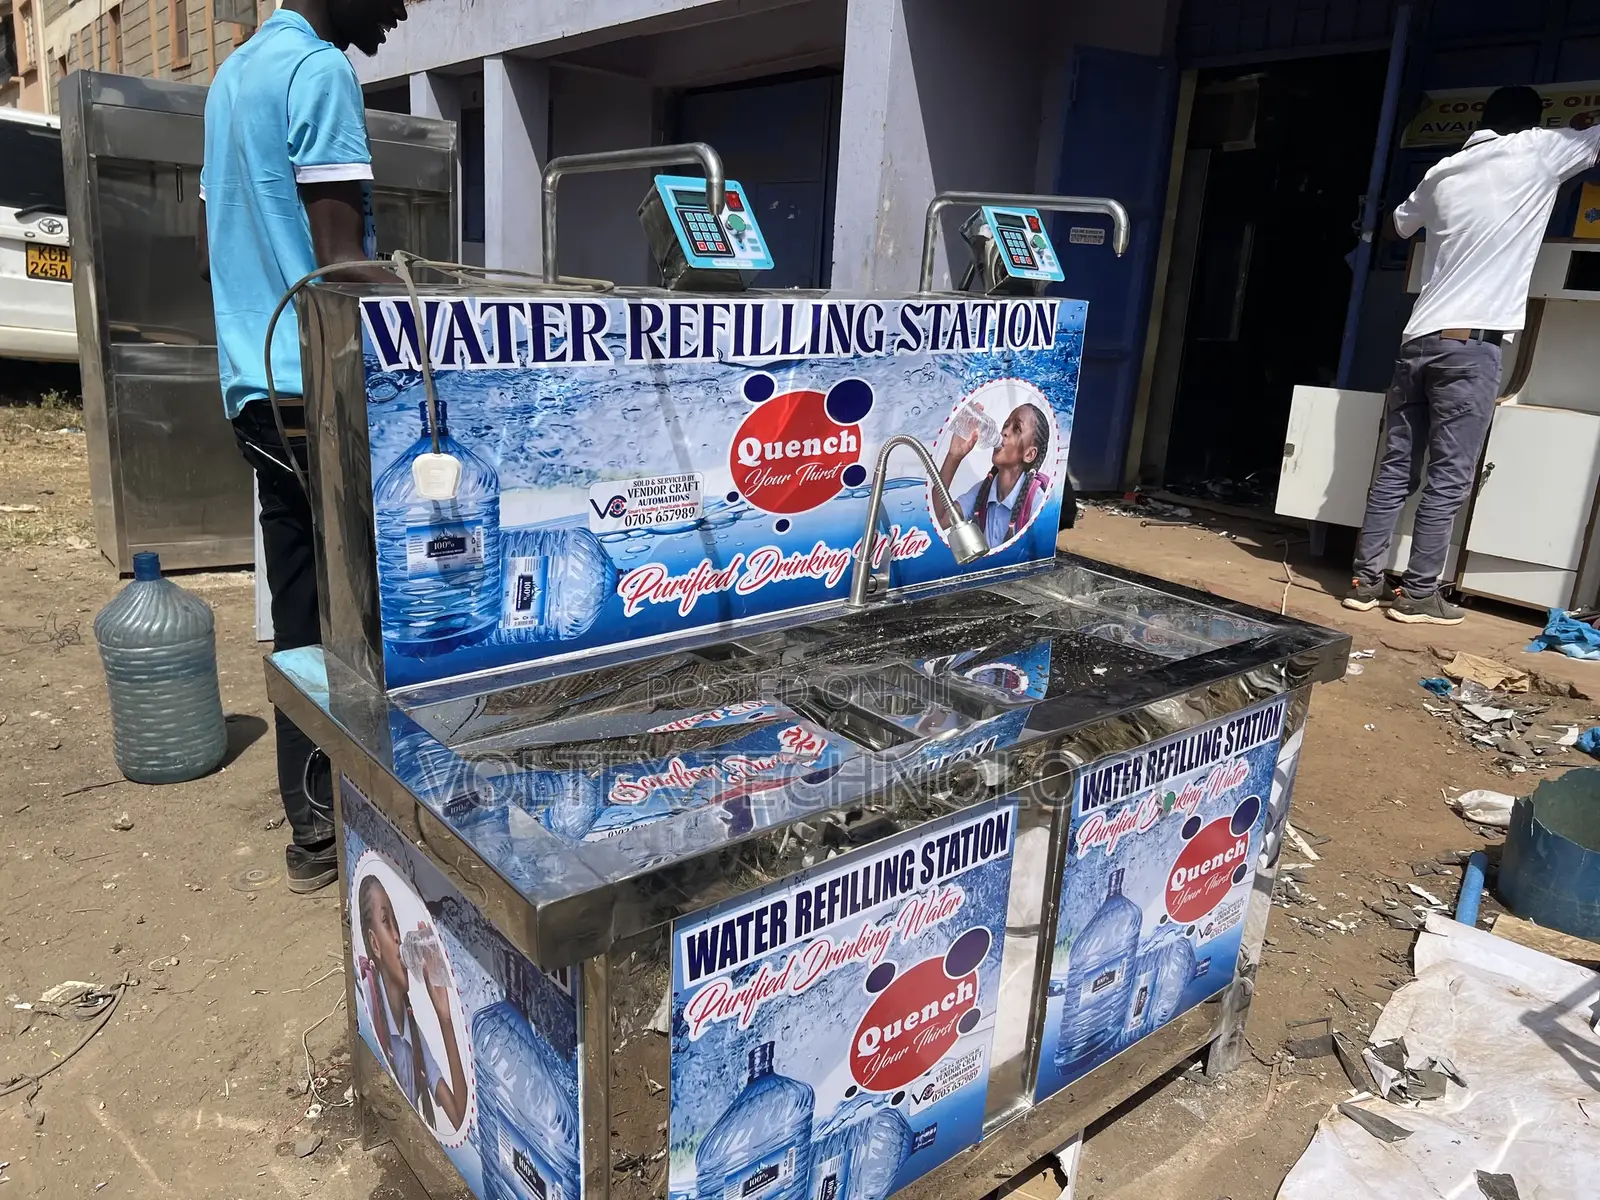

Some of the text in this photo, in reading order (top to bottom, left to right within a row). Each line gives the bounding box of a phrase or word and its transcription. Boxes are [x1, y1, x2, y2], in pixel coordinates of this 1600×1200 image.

[30, 261, 68, 279] 245A
[38, 246, 68, 263] KCD
[361, 299, 1058, 366] WATER REFILLING STATION
[737, 429, 858, 468] Quench
[627, 480, 701, 499] VENDOR CRAFT
[637, 493, 690, 507] AUTOMATIONS
[657, 474, 687, 485] SERVICED
[744, 461, 846, 498] Your Thirst
[624, 506, 696, 527] 0705 657989
[621, 527, 928, 613] Purified Drinking Water
[1081, 702, 1284, 812] WATER REFILLING STATION
[1079, 800, 1144, 853] Purified
[1206, 758, 1248, 797] Water
[1170, 838, 1247, 892] Quench
[686, 811, 1011, 983] WATER REFILLING STATION
[689, 887, 964, 1036] Purified Drinking Water
[857, 980, 974, 1058] Quench
[863, 1045, 910, 1087] Your
[913, 1012, 960, 1054] Thirst
